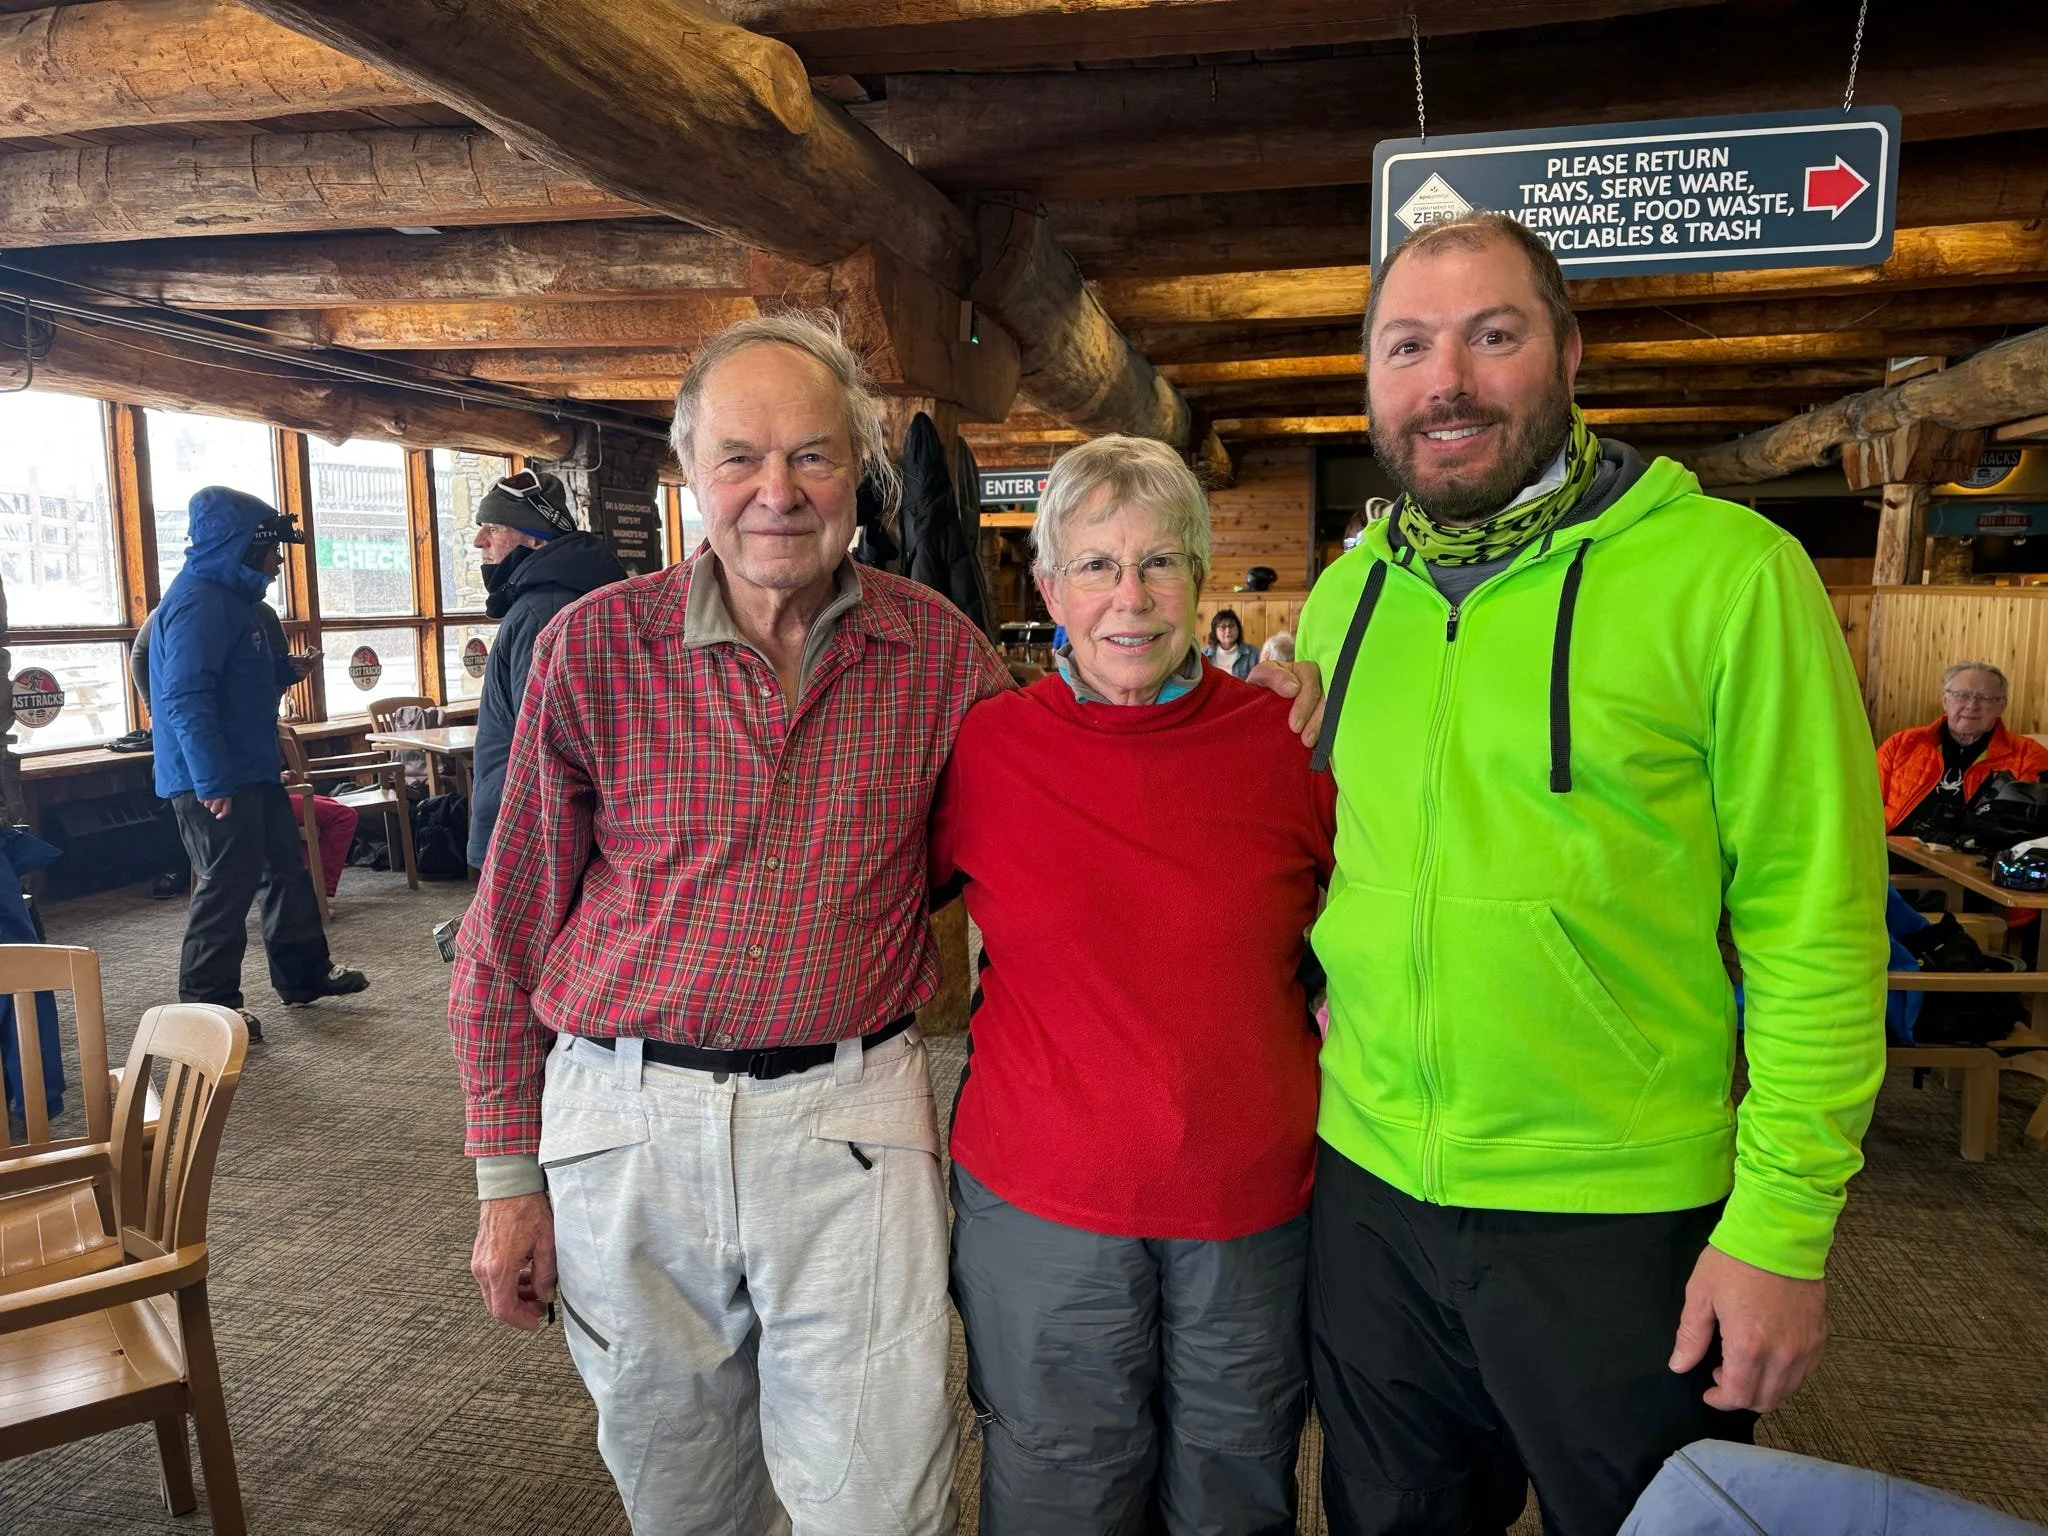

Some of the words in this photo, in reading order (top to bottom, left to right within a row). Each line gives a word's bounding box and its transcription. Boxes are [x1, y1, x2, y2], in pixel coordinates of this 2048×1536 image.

[1547, 154, 1628, 178] PLEASE
[1635, 147, 1729, 172] RETURN
[1520, 181, 1594, 204] TRAYS,
[1600, 176, 1672, 199] SERVE
[1679, 171, 1755, 195] WARE,
[1413, 211, 1454, 224] ZERO
[1487, 203, 1626, 228] VERWARE,
[1634, 198, 1700, 222] FOOD
[1707, 193, 1795, 217] WASTE,
[1535, 225, 1654, 250] YCLABLES
[1660, 224, 1678, 245] &
[1685, 219, 1761, 243] TRASH
[1980, 451, 2018, 465] RACKS
[985, 478, 1035, 495] ENTER
[332, 550, 409, 571] CHECK
[349, 667, 361, 677] FAST
[12, 696, 29, 709] AST
[30, 693, 64, 707] TRACKS
